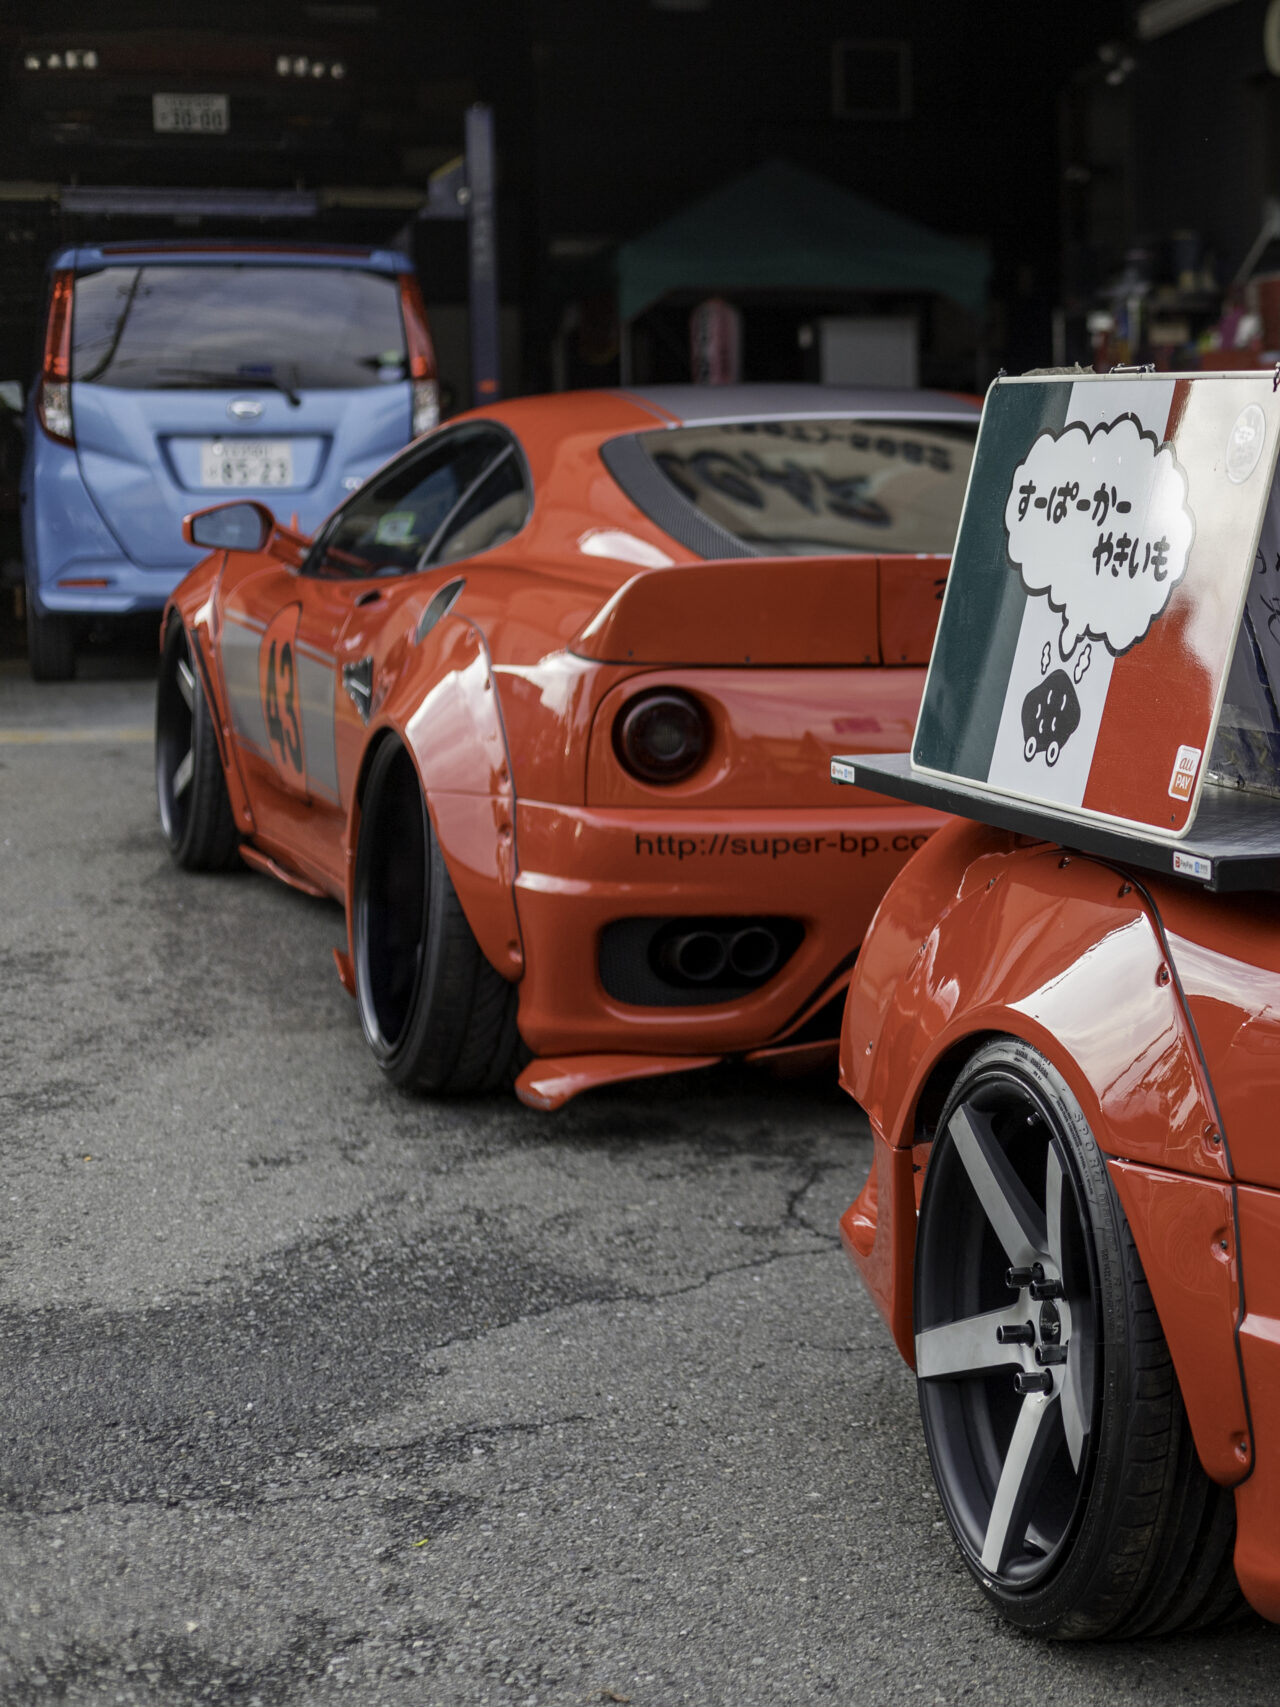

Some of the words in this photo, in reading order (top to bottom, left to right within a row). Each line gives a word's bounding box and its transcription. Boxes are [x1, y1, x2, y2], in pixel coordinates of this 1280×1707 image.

[1018, 480, 1132, 526] すーぱーかー
[1093, 532, 1170, 581] やきいも
[264, 638, 304, 775] 43
[1175, 775, 1191, 790] PAY
[1179, 758, 1194, 772] au
